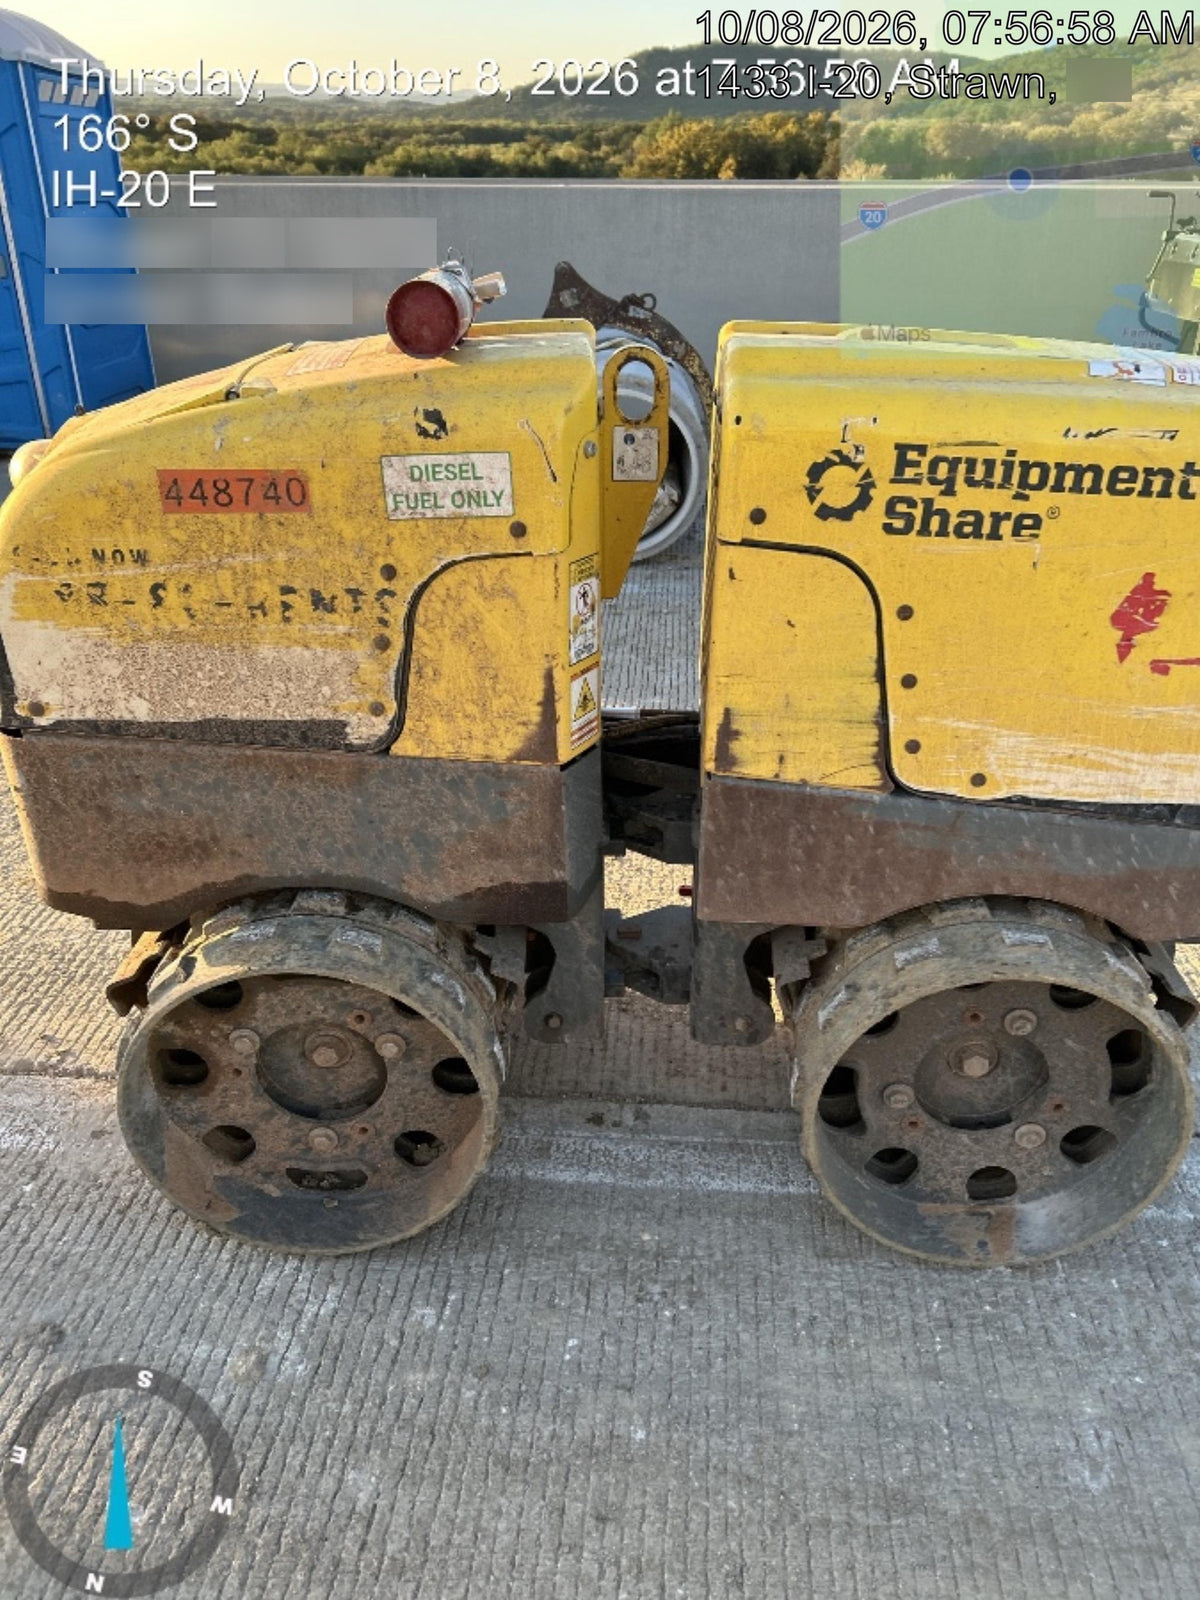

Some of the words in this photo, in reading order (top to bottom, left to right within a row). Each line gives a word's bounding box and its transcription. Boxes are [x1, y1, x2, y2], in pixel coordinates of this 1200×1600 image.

[409, 462, 485, 483] DIESEL
[889, 443, 1200, 502] Equipment
[164, 477, 308, 508] 448740
[392, 490, 445, 512] FUEL
[450, 488, 506, 509] ONLY
[91, 547, 149, 567] NOW
